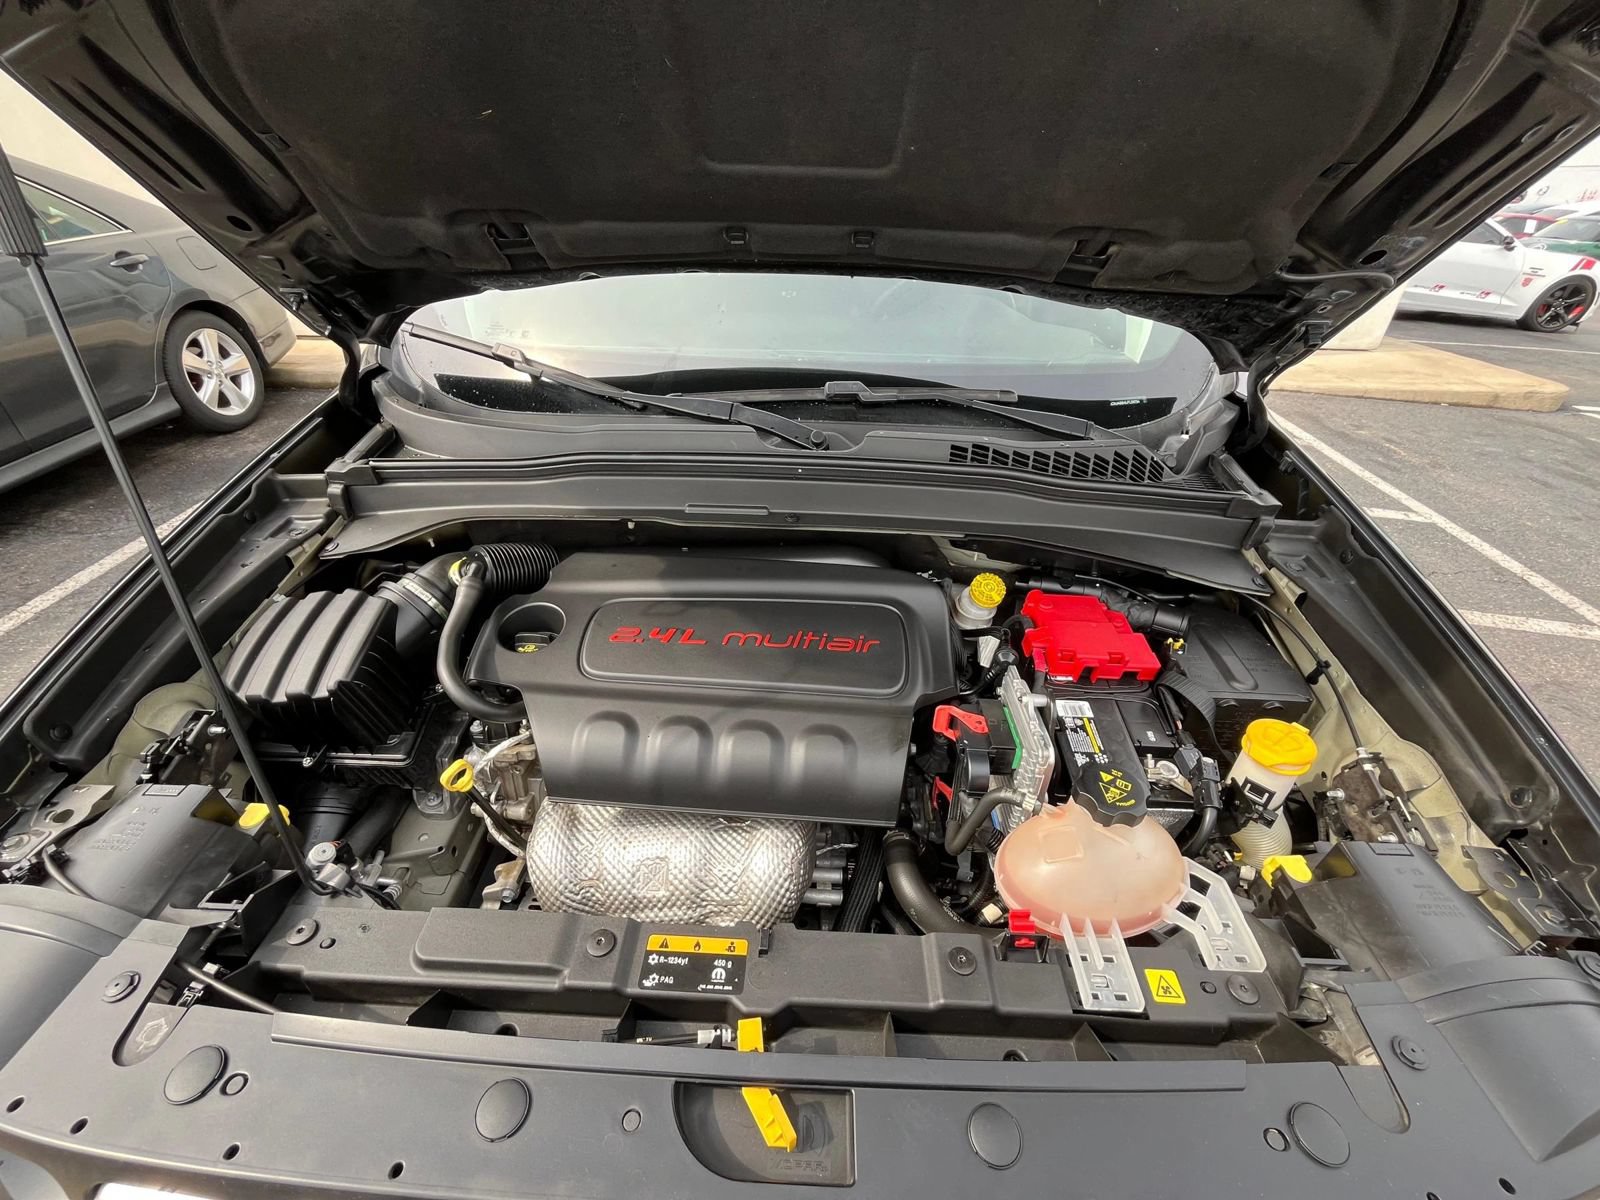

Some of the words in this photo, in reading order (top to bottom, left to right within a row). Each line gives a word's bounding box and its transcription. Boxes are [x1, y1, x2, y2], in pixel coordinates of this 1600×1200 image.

[608, 626, 707, 645] 2.4L
[721, 630, 880, 653] multiair
[659, 956, 688, 966] R-1234yf
[713, 959, 726, 967] 450
[727, 960, 733, 969] g
[659, 975, 674, 984] PAG
